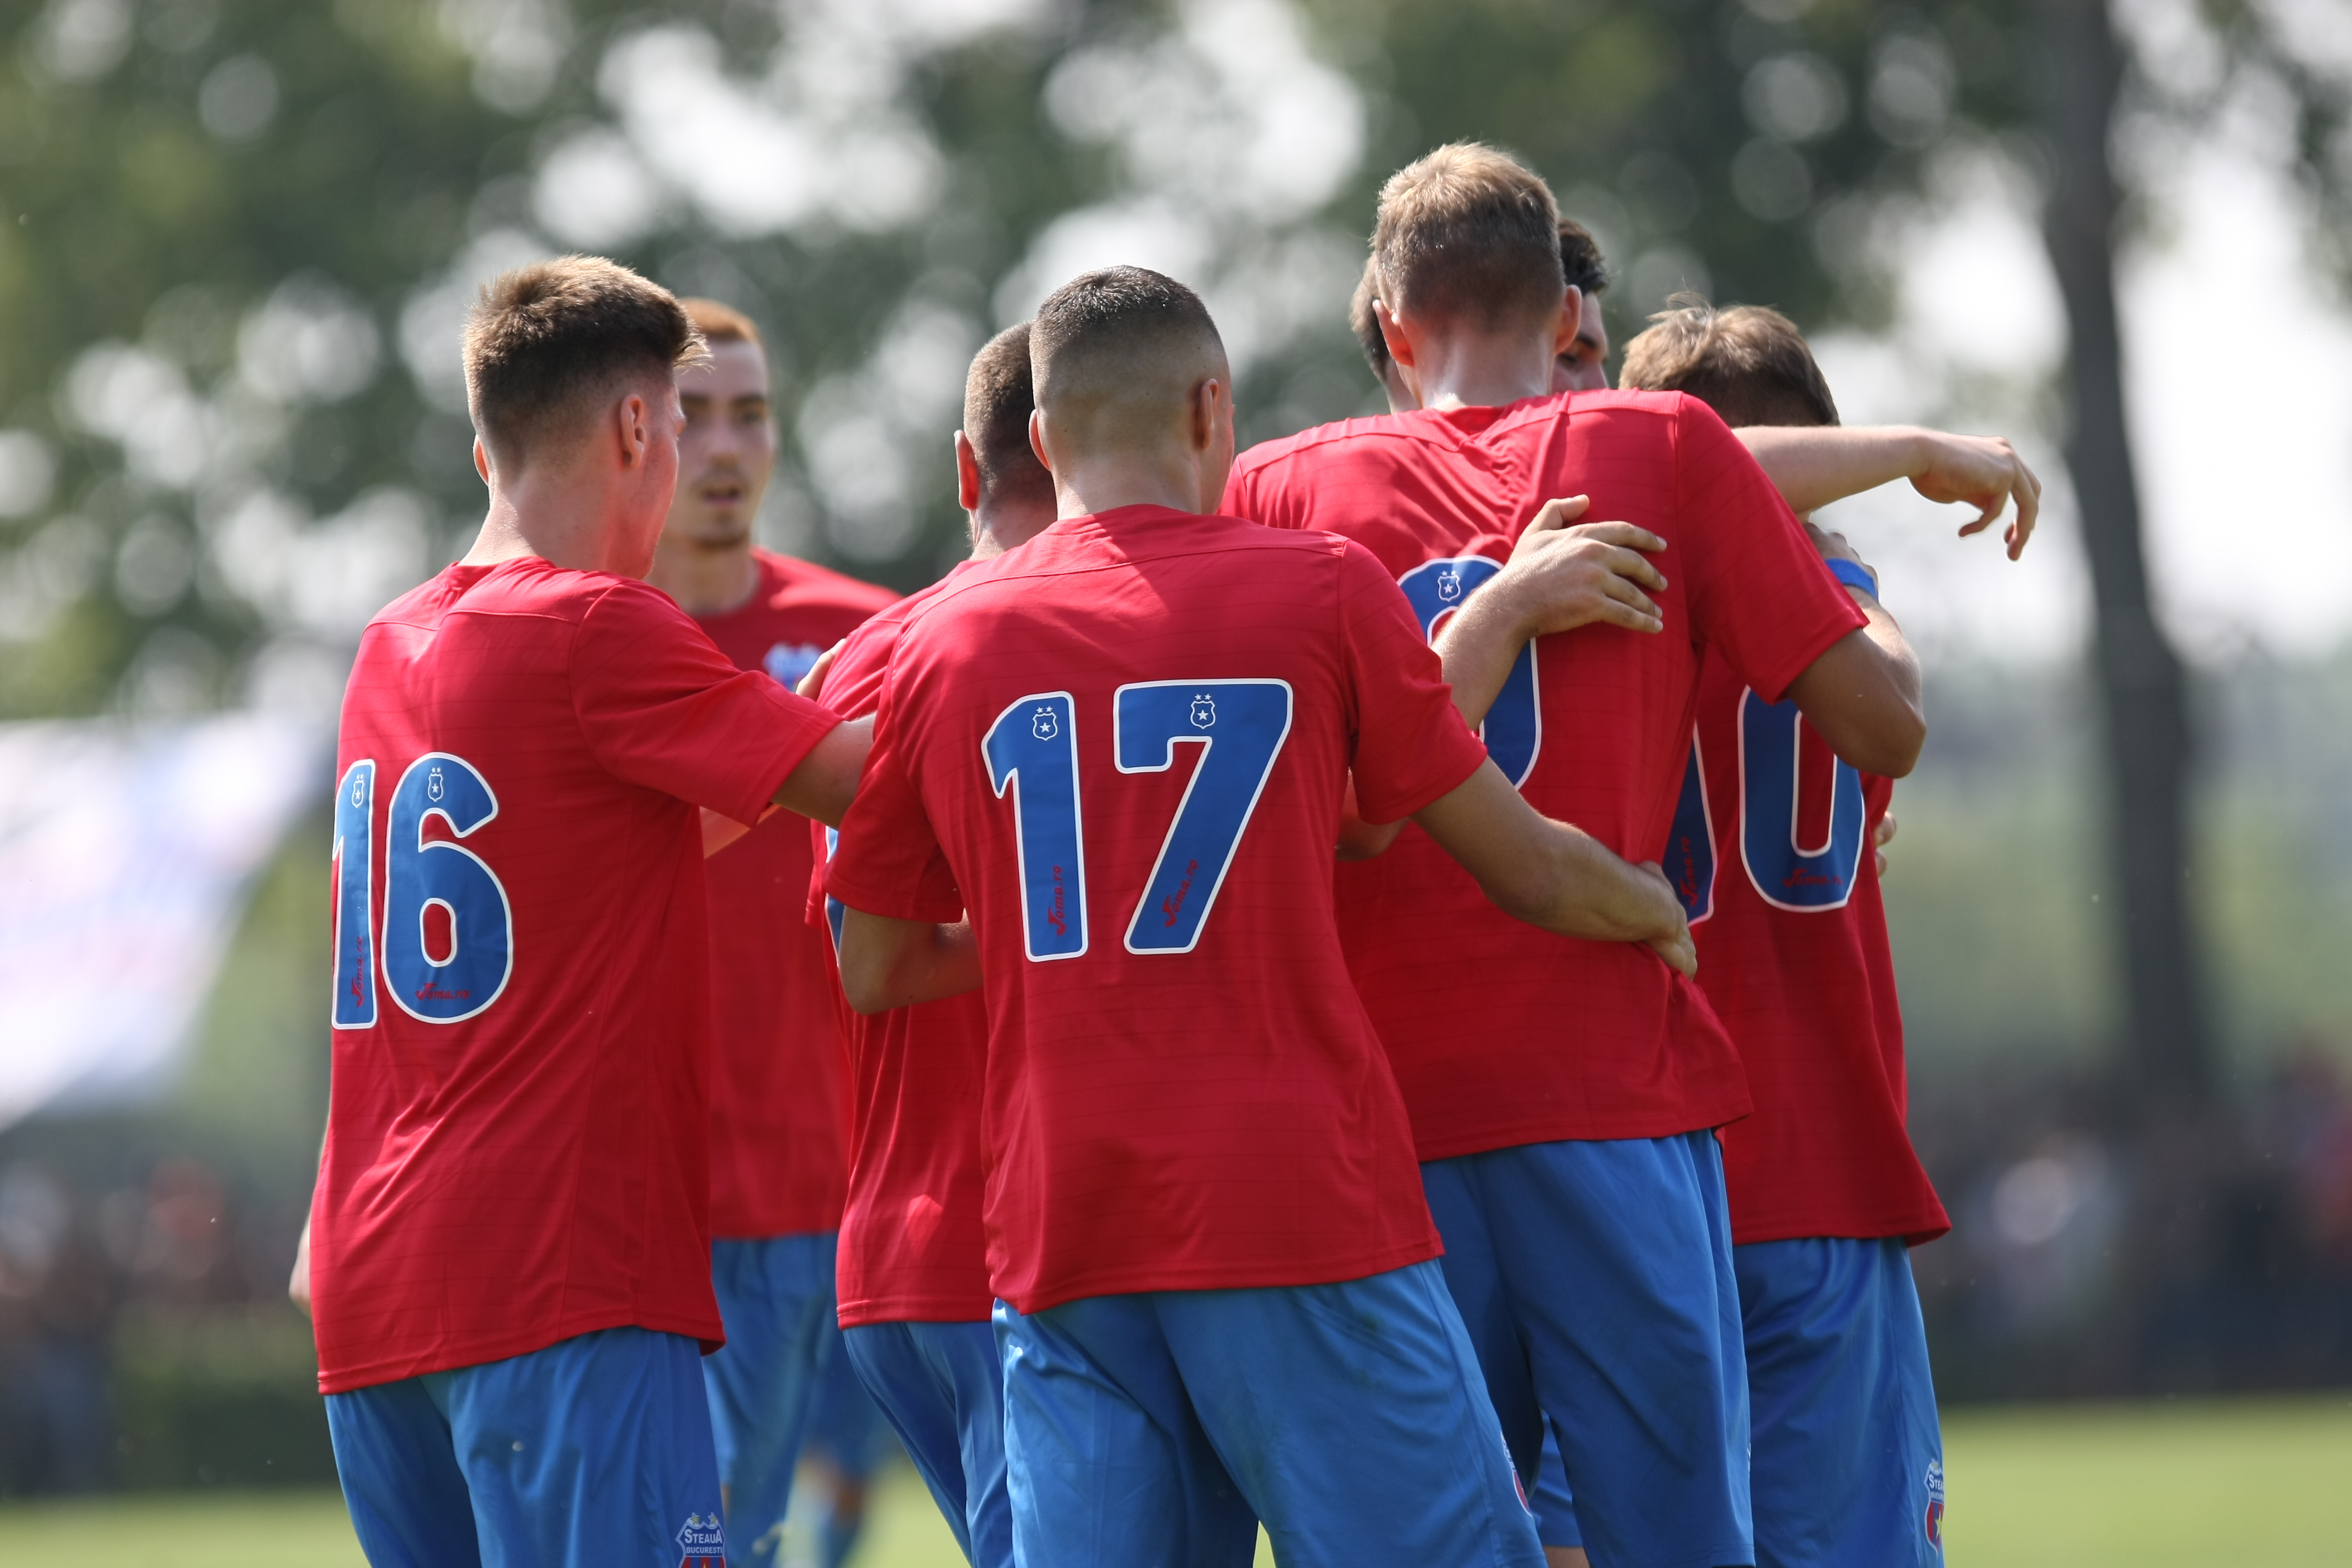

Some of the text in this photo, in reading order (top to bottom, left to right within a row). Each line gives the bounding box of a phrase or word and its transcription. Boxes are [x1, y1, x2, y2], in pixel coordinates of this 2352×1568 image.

[981, 678, 1293, 963] 17
[332, 751, 513, 1030] 16
[1048, 866, 1067, 936] Joma.ro
[1161, 859, 1198, 927] Joma.ro
[351, 936, 364, 1008] Joma.ro
[416, 982, 470, 1001] Joma.ro
[684, 1529, 723, 1544] STEAUA
